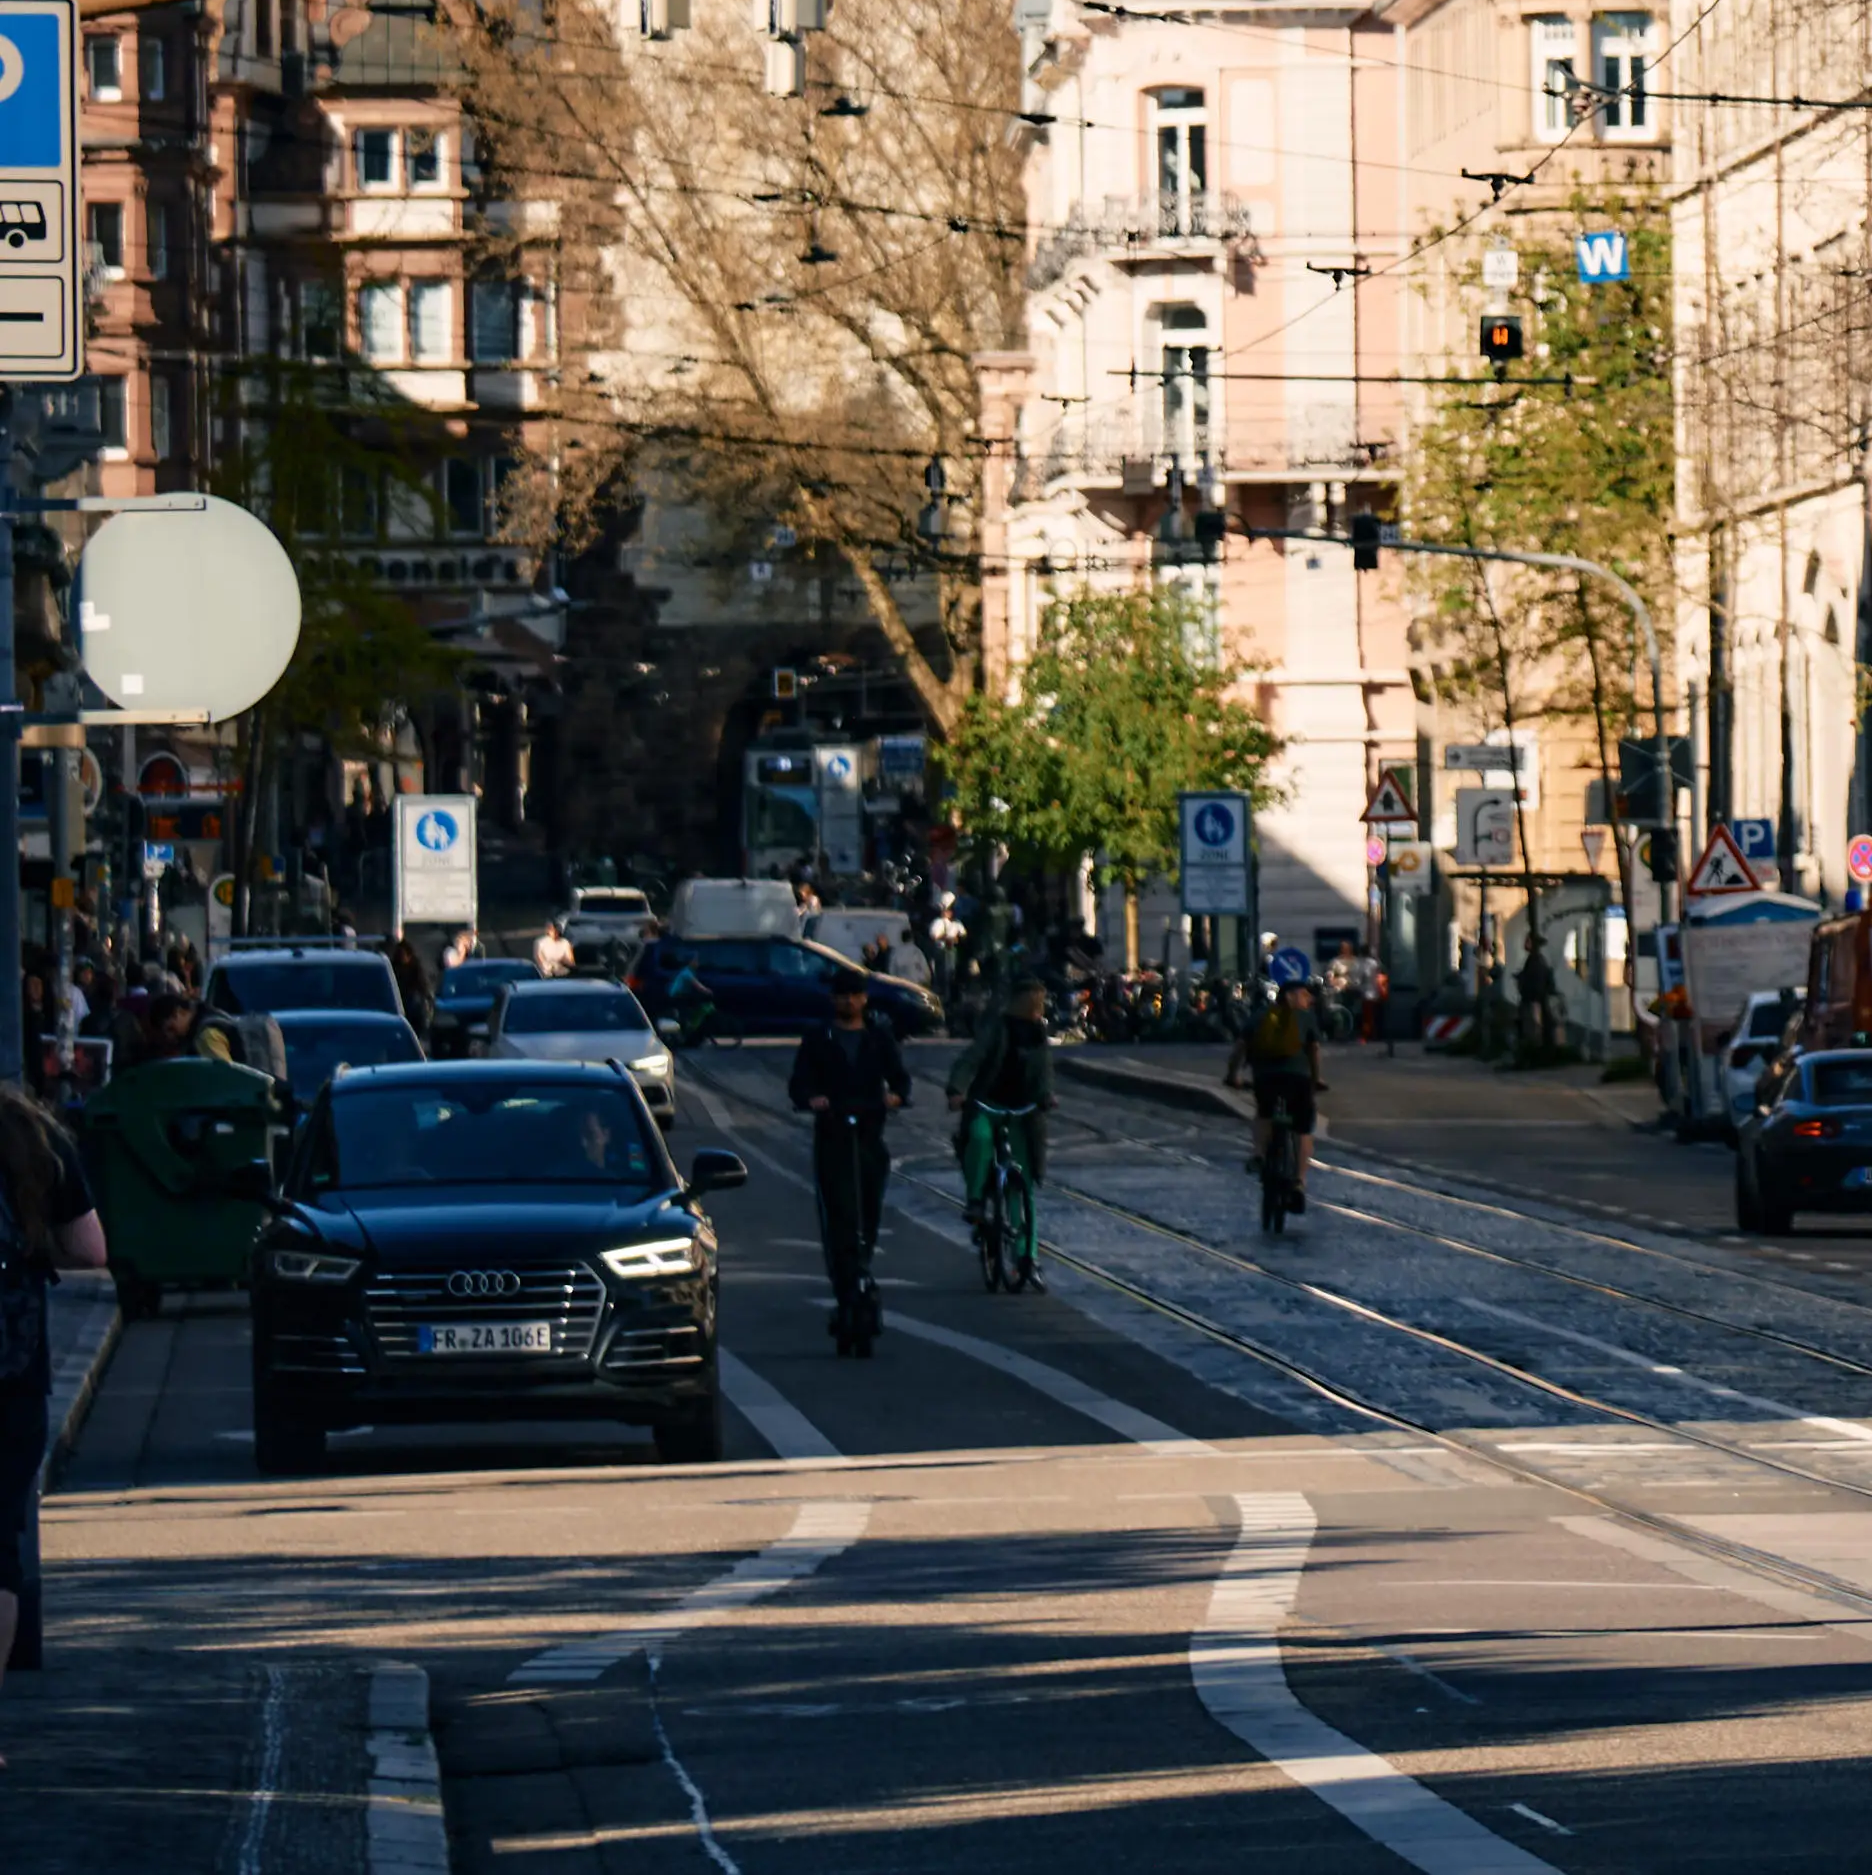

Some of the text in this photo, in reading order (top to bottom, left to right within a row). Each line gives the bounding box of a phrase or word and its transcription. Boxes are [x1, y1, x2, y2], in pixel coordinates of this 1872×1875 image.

[1577, 235, 1625, 276] W
[1741, 821, 1765, 855] P
[432, 1326, 548, 1350] FR ZA 106E
